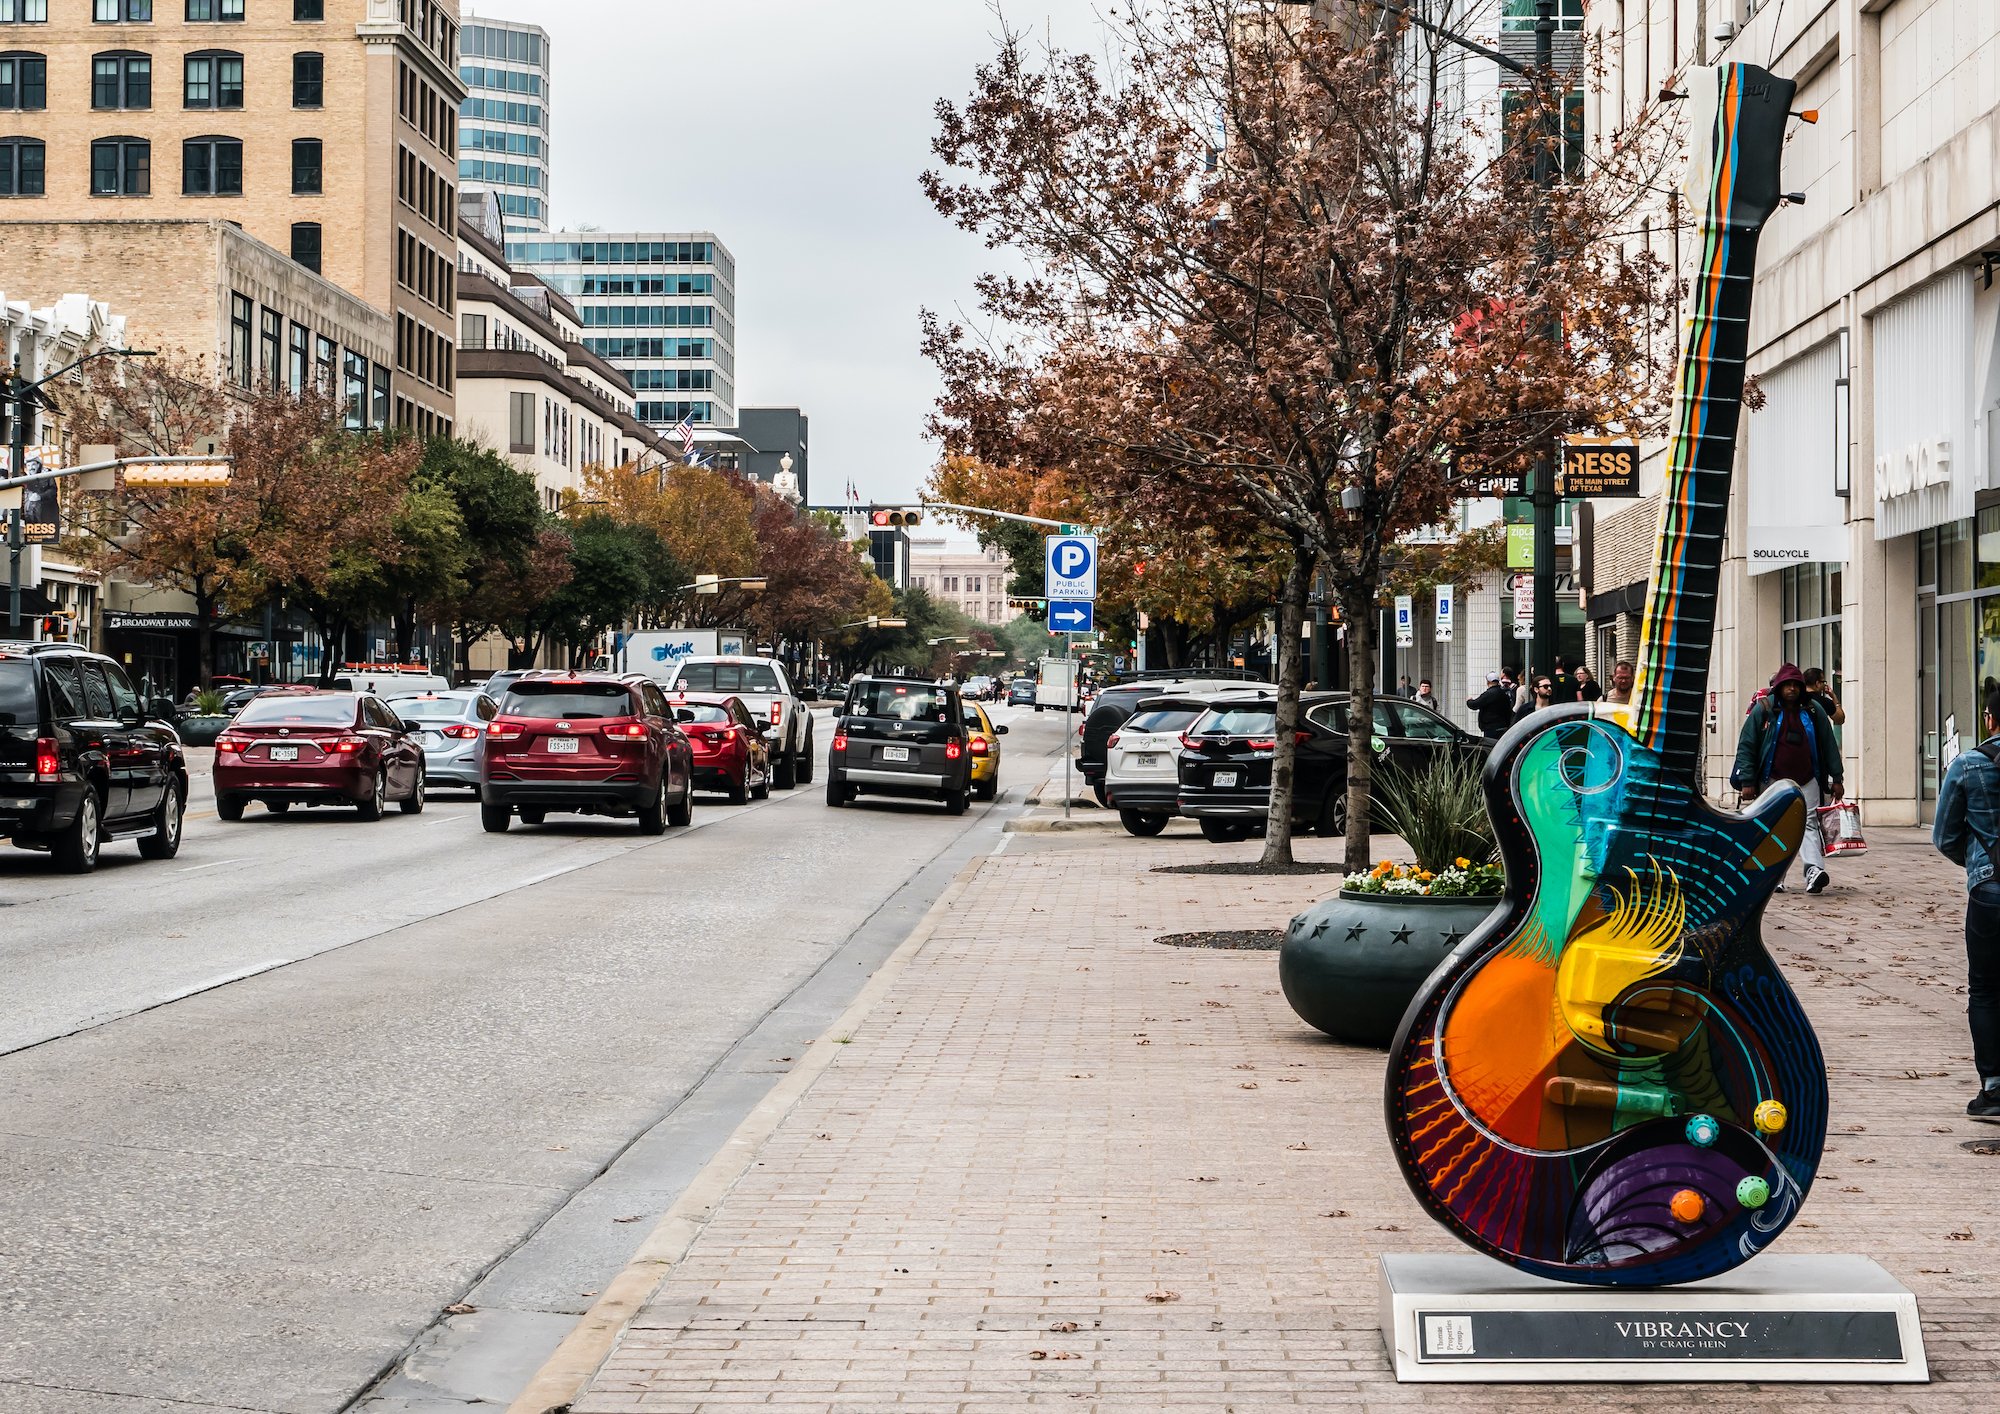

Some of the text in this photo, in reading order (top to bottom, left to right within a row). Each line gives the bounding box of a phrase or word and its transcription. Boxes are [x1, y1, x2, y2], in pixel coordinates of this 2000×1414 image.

[1511, 526, 1534, 540] zipca
[1753, 549, 1809, 558] SOULCYCLE
[1056, 580, 1086, 588] PUBLIC
[1053, 588, 1089, 596] PARKING
[122, 619, 192, 627] BROADWAY BANK
[664, 641, 694, 659] Kwik
[1446, 1320, 1455, 1351] Properties
[1615, 1322, 1749, 1338] VIBRANCY
[1456, 1330, 1464, 1351] Group
[1643, 1340, 1727, 1348] BY CRAIG HEIN
